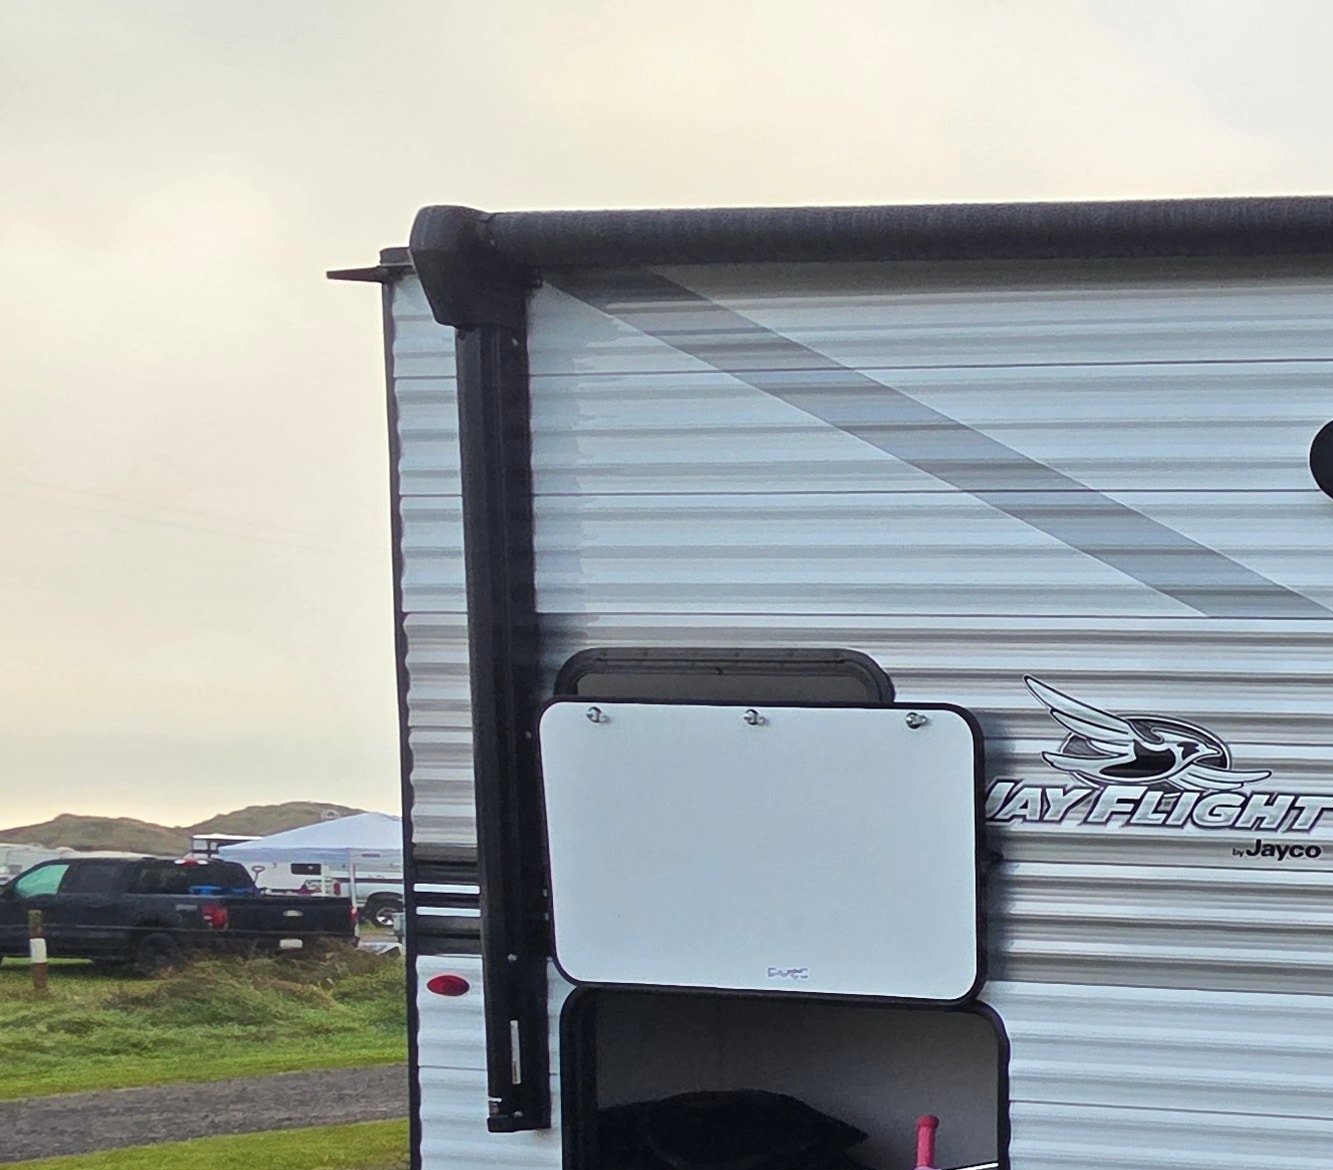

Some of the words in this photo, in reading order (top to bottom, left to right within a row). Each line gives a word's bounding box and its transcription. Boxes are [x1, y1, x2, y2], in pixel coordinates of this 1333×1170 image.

[985, 779, 1097, 826] JAY
[1232, 847, 1245, 859] by
[1245, 838, 1323, 861] Jayco
